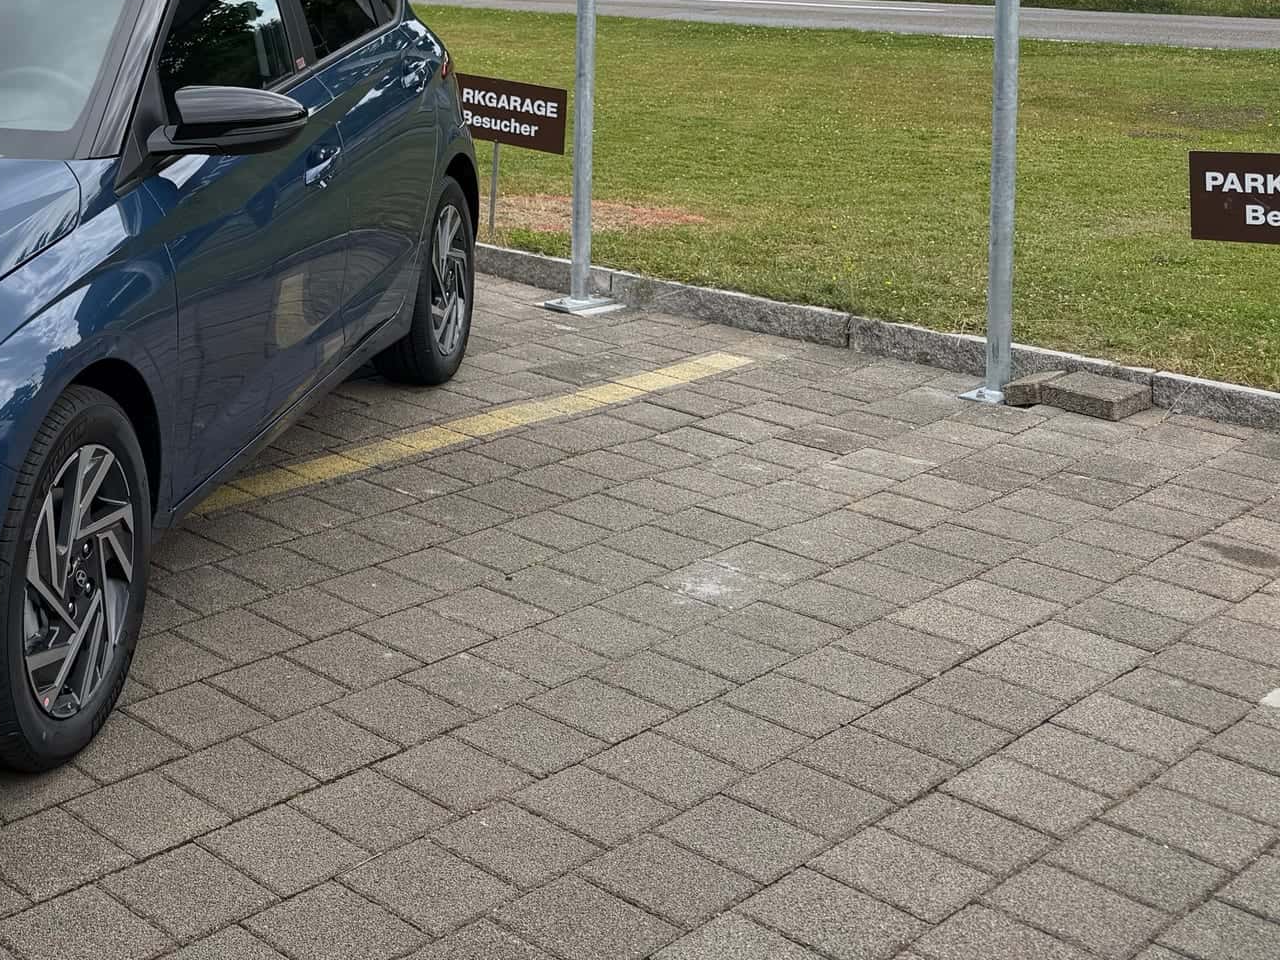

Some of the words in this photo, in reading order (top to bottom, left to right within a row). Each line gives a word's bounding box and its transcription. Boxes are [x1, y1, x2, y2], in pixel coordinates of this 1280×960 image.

[462, 87, 559, 119] RKGARAGE
[463, 109, 539, 137] Besucher
[1205, 171, 1280, 195] PARK
